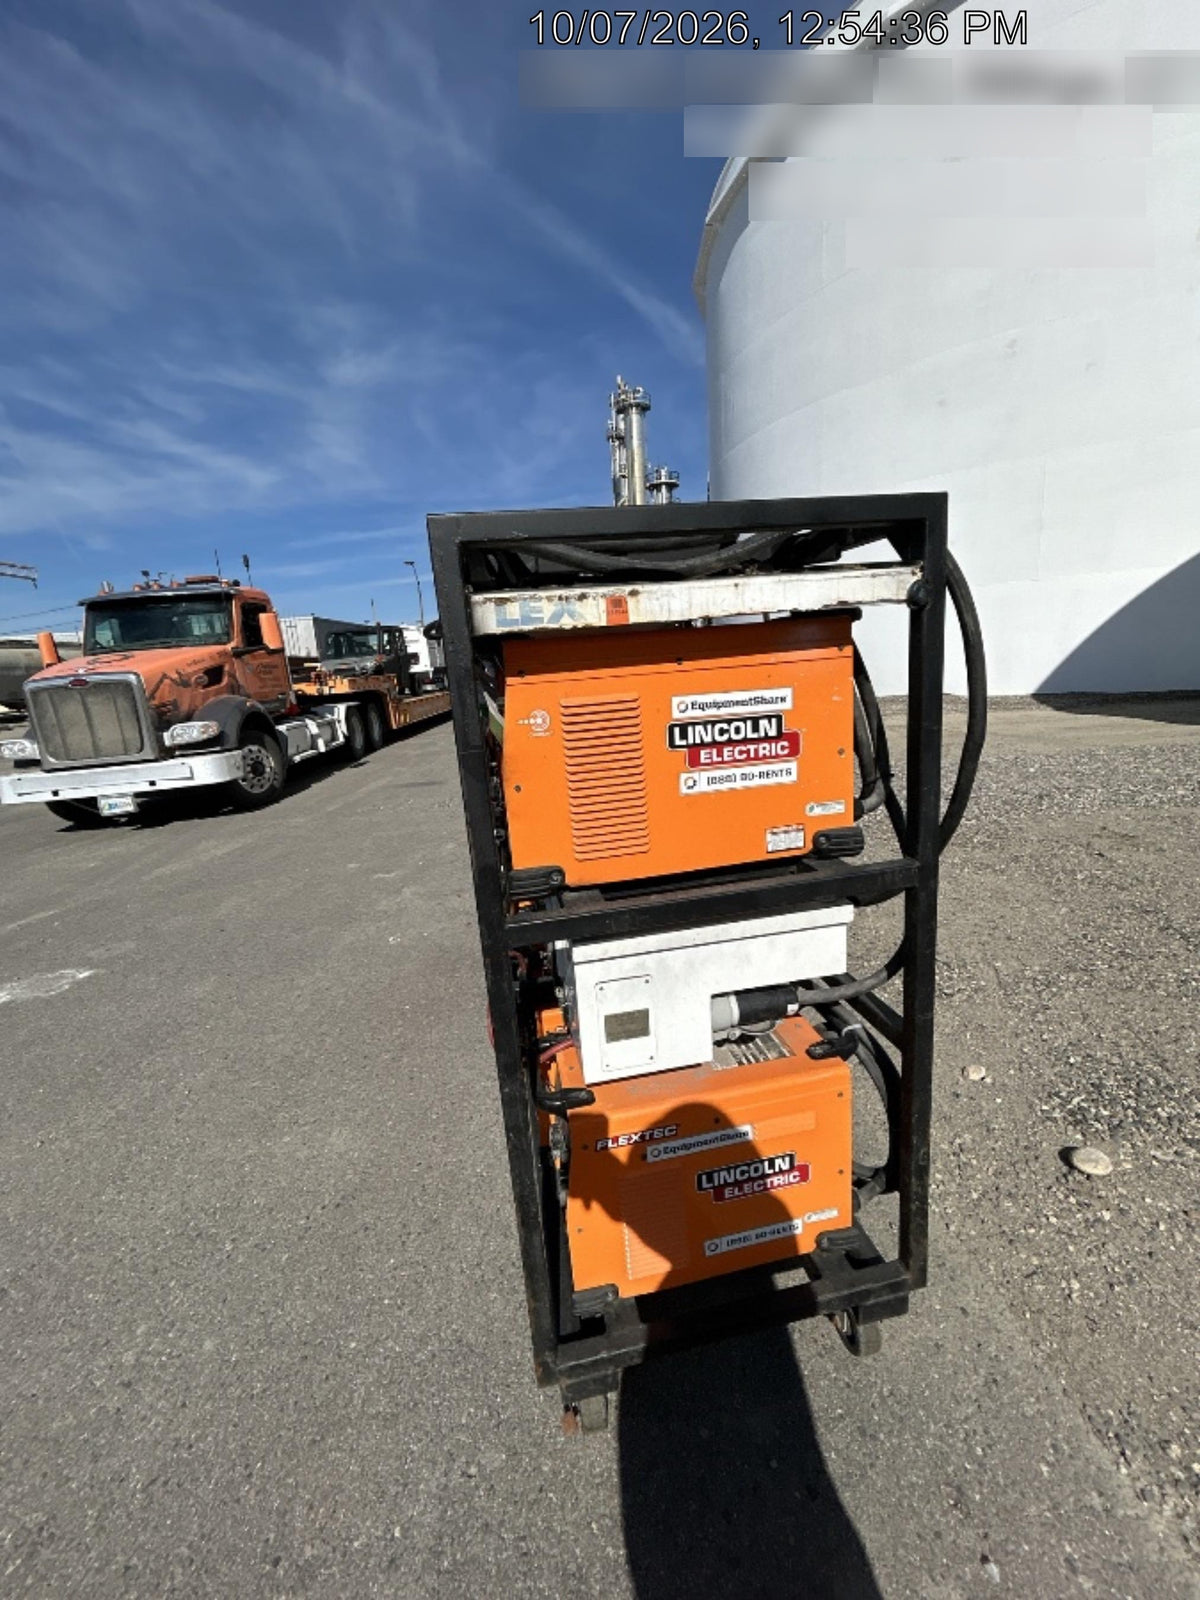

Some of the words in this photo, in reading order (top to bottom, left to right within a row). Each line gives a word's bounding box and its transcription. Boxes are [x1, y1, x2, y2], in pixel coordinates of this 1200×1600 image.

[691, 695, 786, 712] EquipmentShare
[673, 717, 778, 746] LINCOLN
[699, 740, 790, 764] ELECTRIC
[596, 1124, 678, 1151] FLEXTEC
[701, 1155, 790, 1189] LINCOLN
[724, 1171, 801, 1199] ELECTRIC
